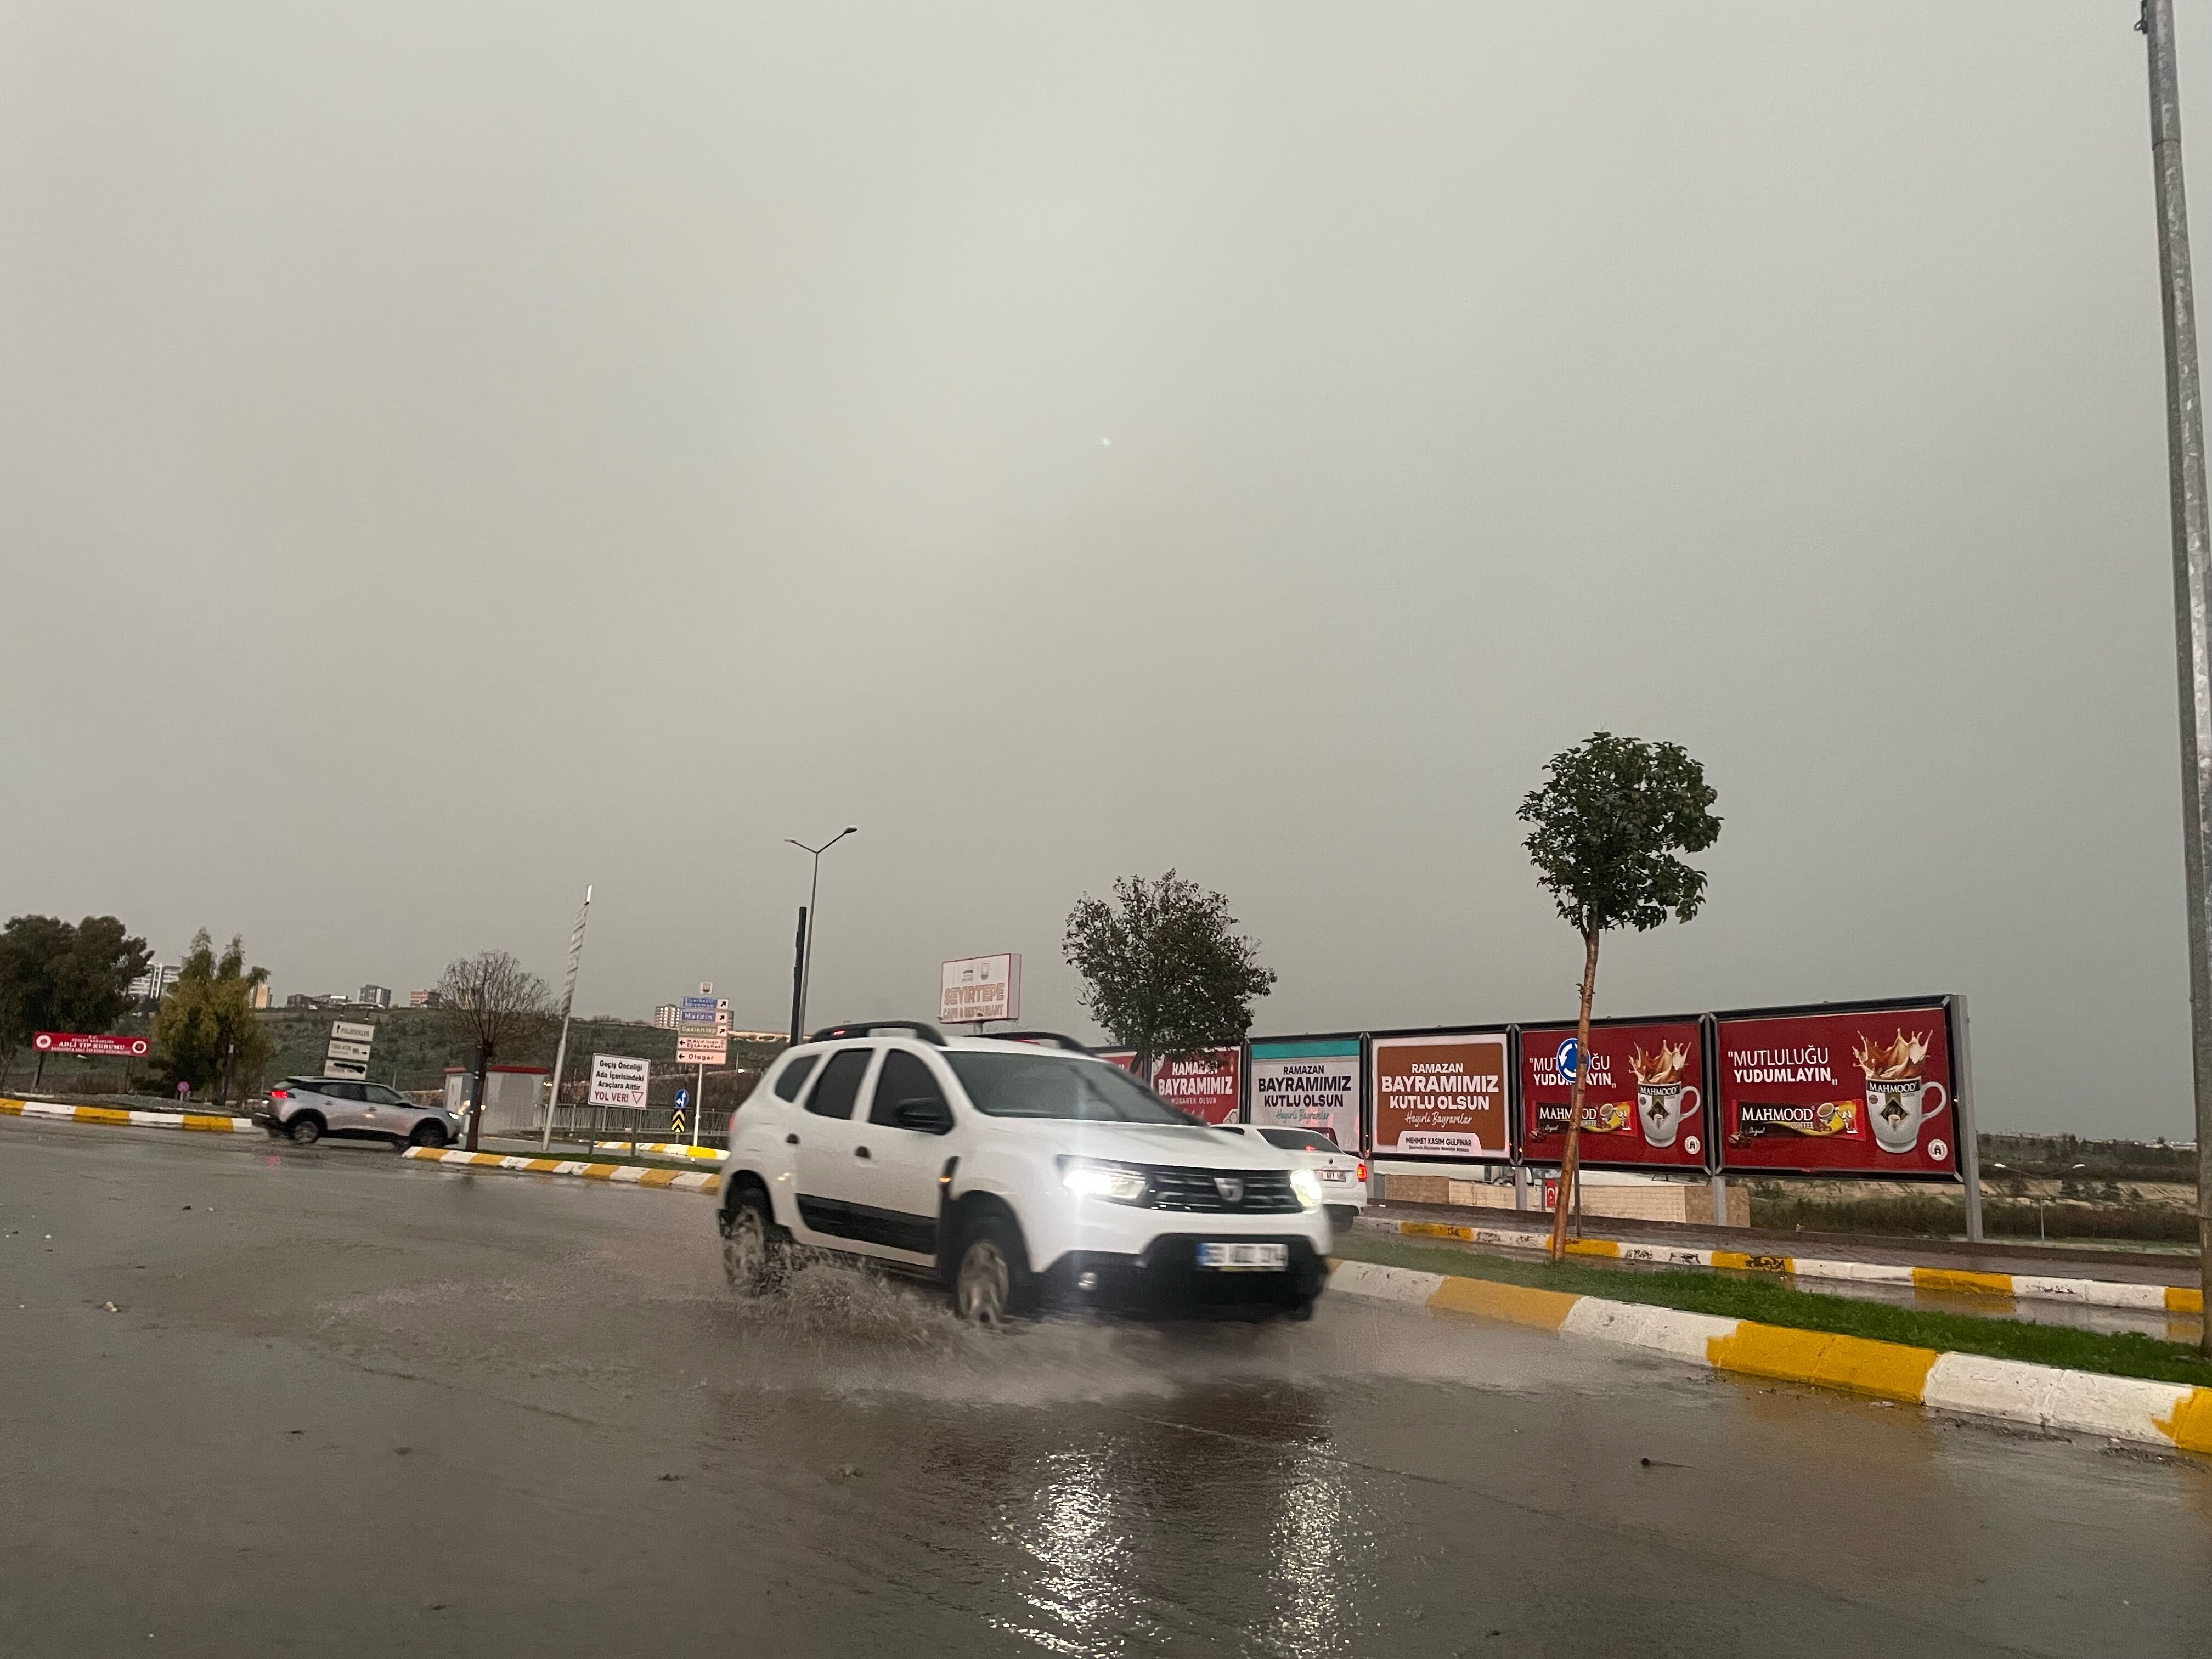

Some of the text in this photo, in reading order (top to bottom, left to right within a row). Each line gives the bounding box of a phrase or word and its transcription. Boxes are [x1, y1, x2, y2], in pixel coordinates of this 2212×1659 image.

[600, 1060, 642, 1072] Geçiş Önceliği
[1283, 1065, 1324, 1075] RAMAZAN
[1412, 1063, 1463, 1073] RAMAZAN
[610, 1070, 644, 1082] İçerisindeki
[598, 1080, 624, 1089] Araçlara
[1158, 1076, 1233, 1096] BAYRAMIMIZ
[1258, 1076, 1351, 1092] BAYRAMIMIZ
[1381, 1075, 1499, 1093] BAYRAMIMIZ
[1870, 1082, 1916, 1093] MAHMOOD
[595, 1091, 629, 1102] YOL VER!
[1640, 1086, 1677, 1096] MAHMOOD
[1264, 1094, 1344, 1107] KUTLU OLSUN
[1390, 1095, 1489, 1110] KUTLU OLSUN
[1404, 1110, 1472, 1128] Hayırlı Bayramlar
[1539, 1107, 1597, 1120] MAHMOD
[1742, 1107, 1813, 1121] MAHMOOD
